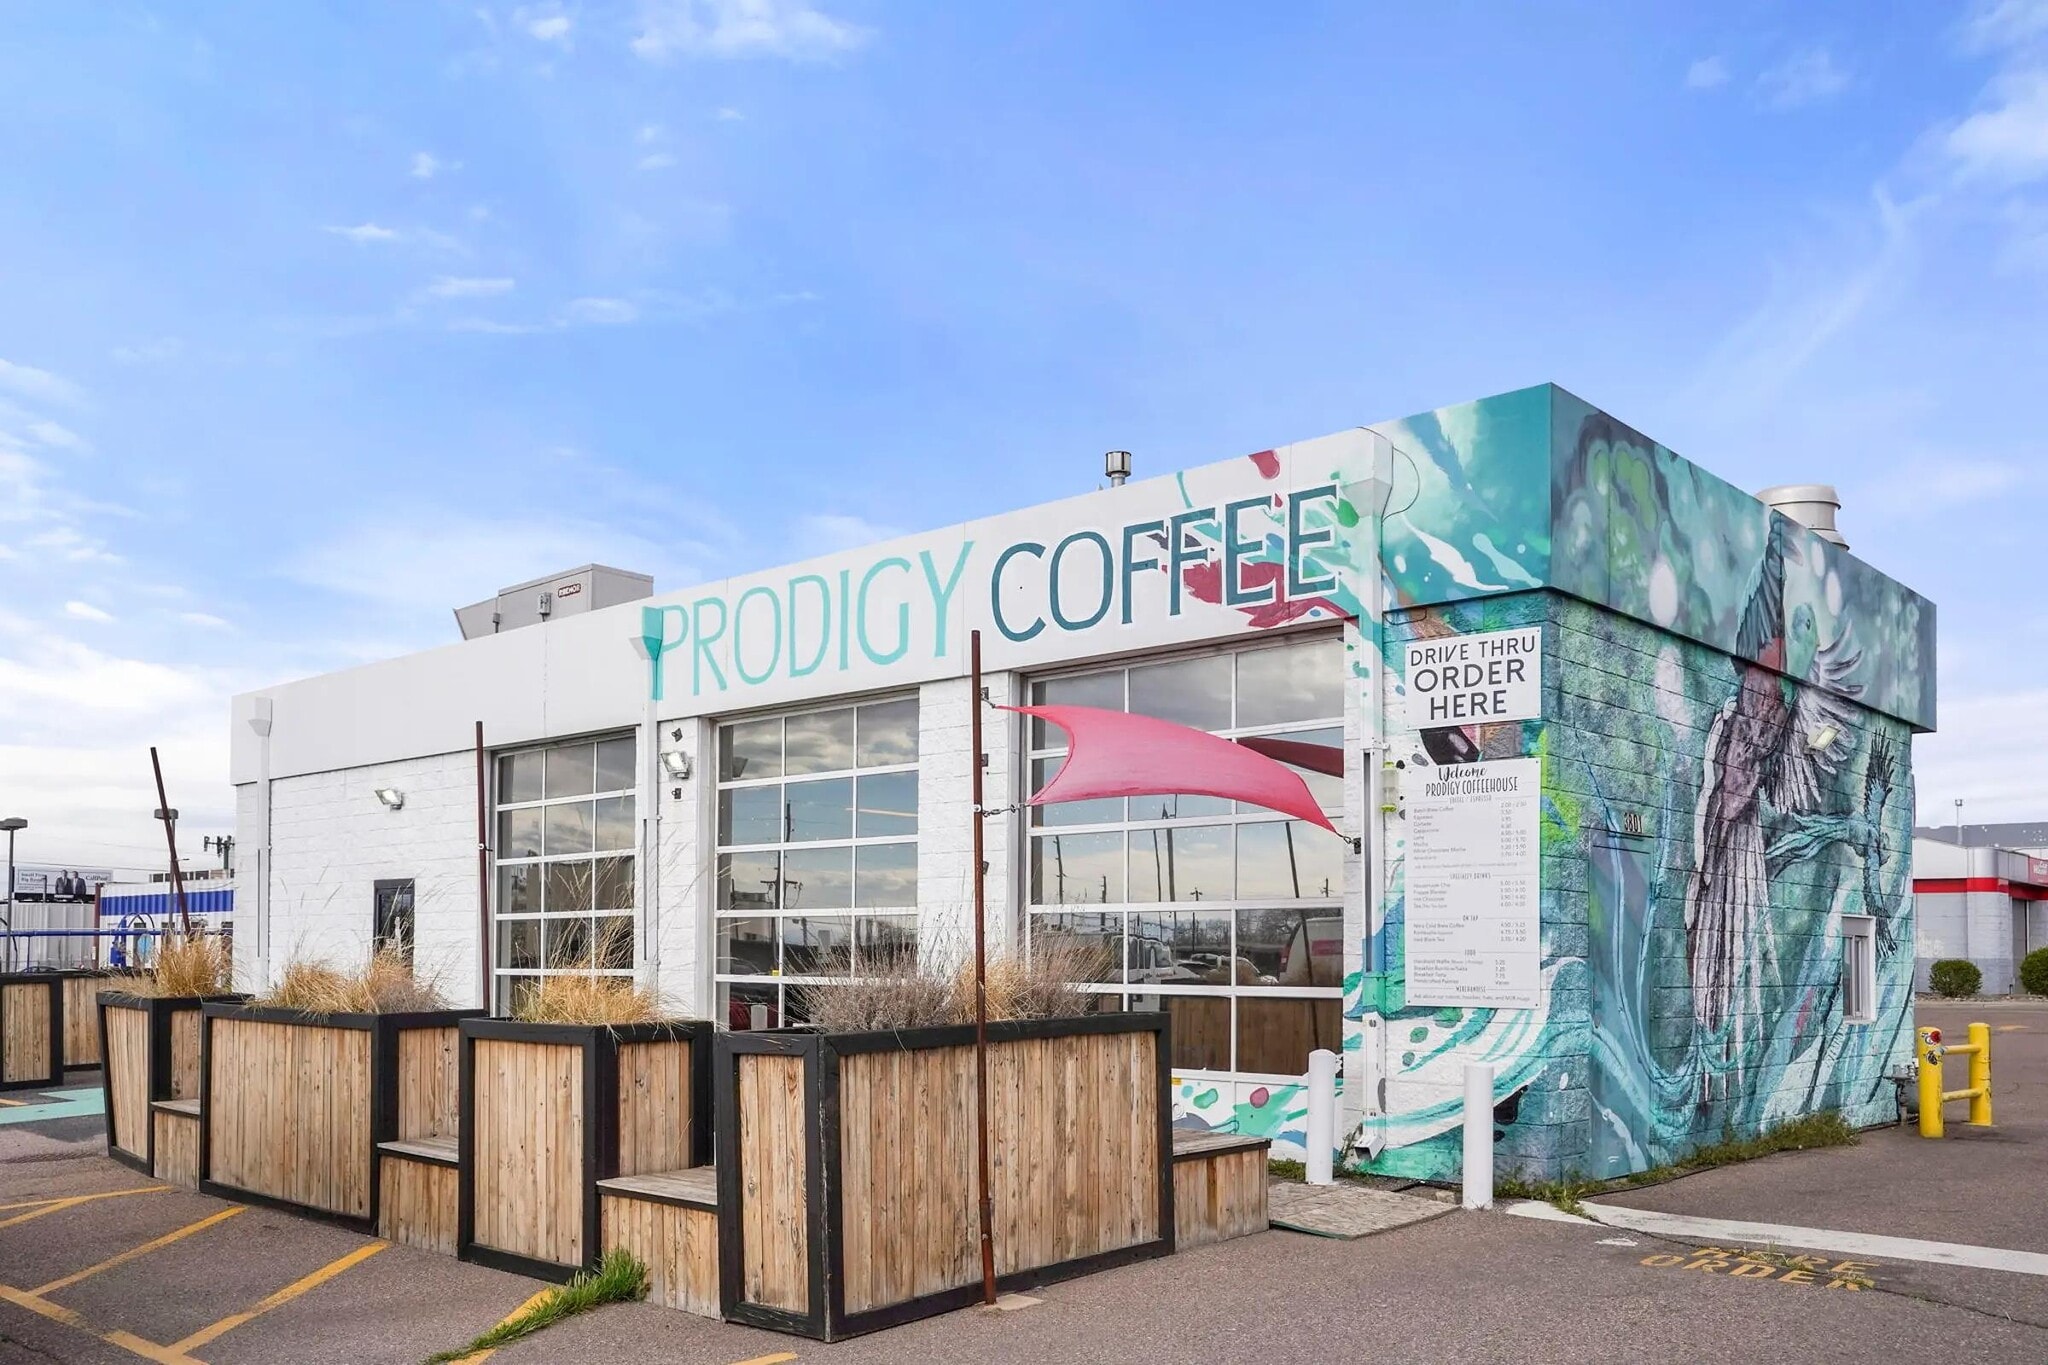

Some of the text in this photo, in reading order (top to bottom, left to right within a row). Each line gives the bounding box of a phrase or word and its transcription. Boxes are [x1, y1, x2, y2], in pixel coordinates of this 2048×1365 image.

[646, 484, 1338, 700] PRODIGY COFFEE
[1411, 635, 1535, 666] DRIVE THRU
[1414, 658, 1525, 692] ORDER
[1430, 690, 1507, 720] HERE
[1426, 777, 1518, 797] PRODIGY COFFEEHOUSE
[1438, 765, 1487, 781] Welcome
[1624, 812, 1643, 834] 3801
[1640, 1255, 1875, 1292] ORDER
